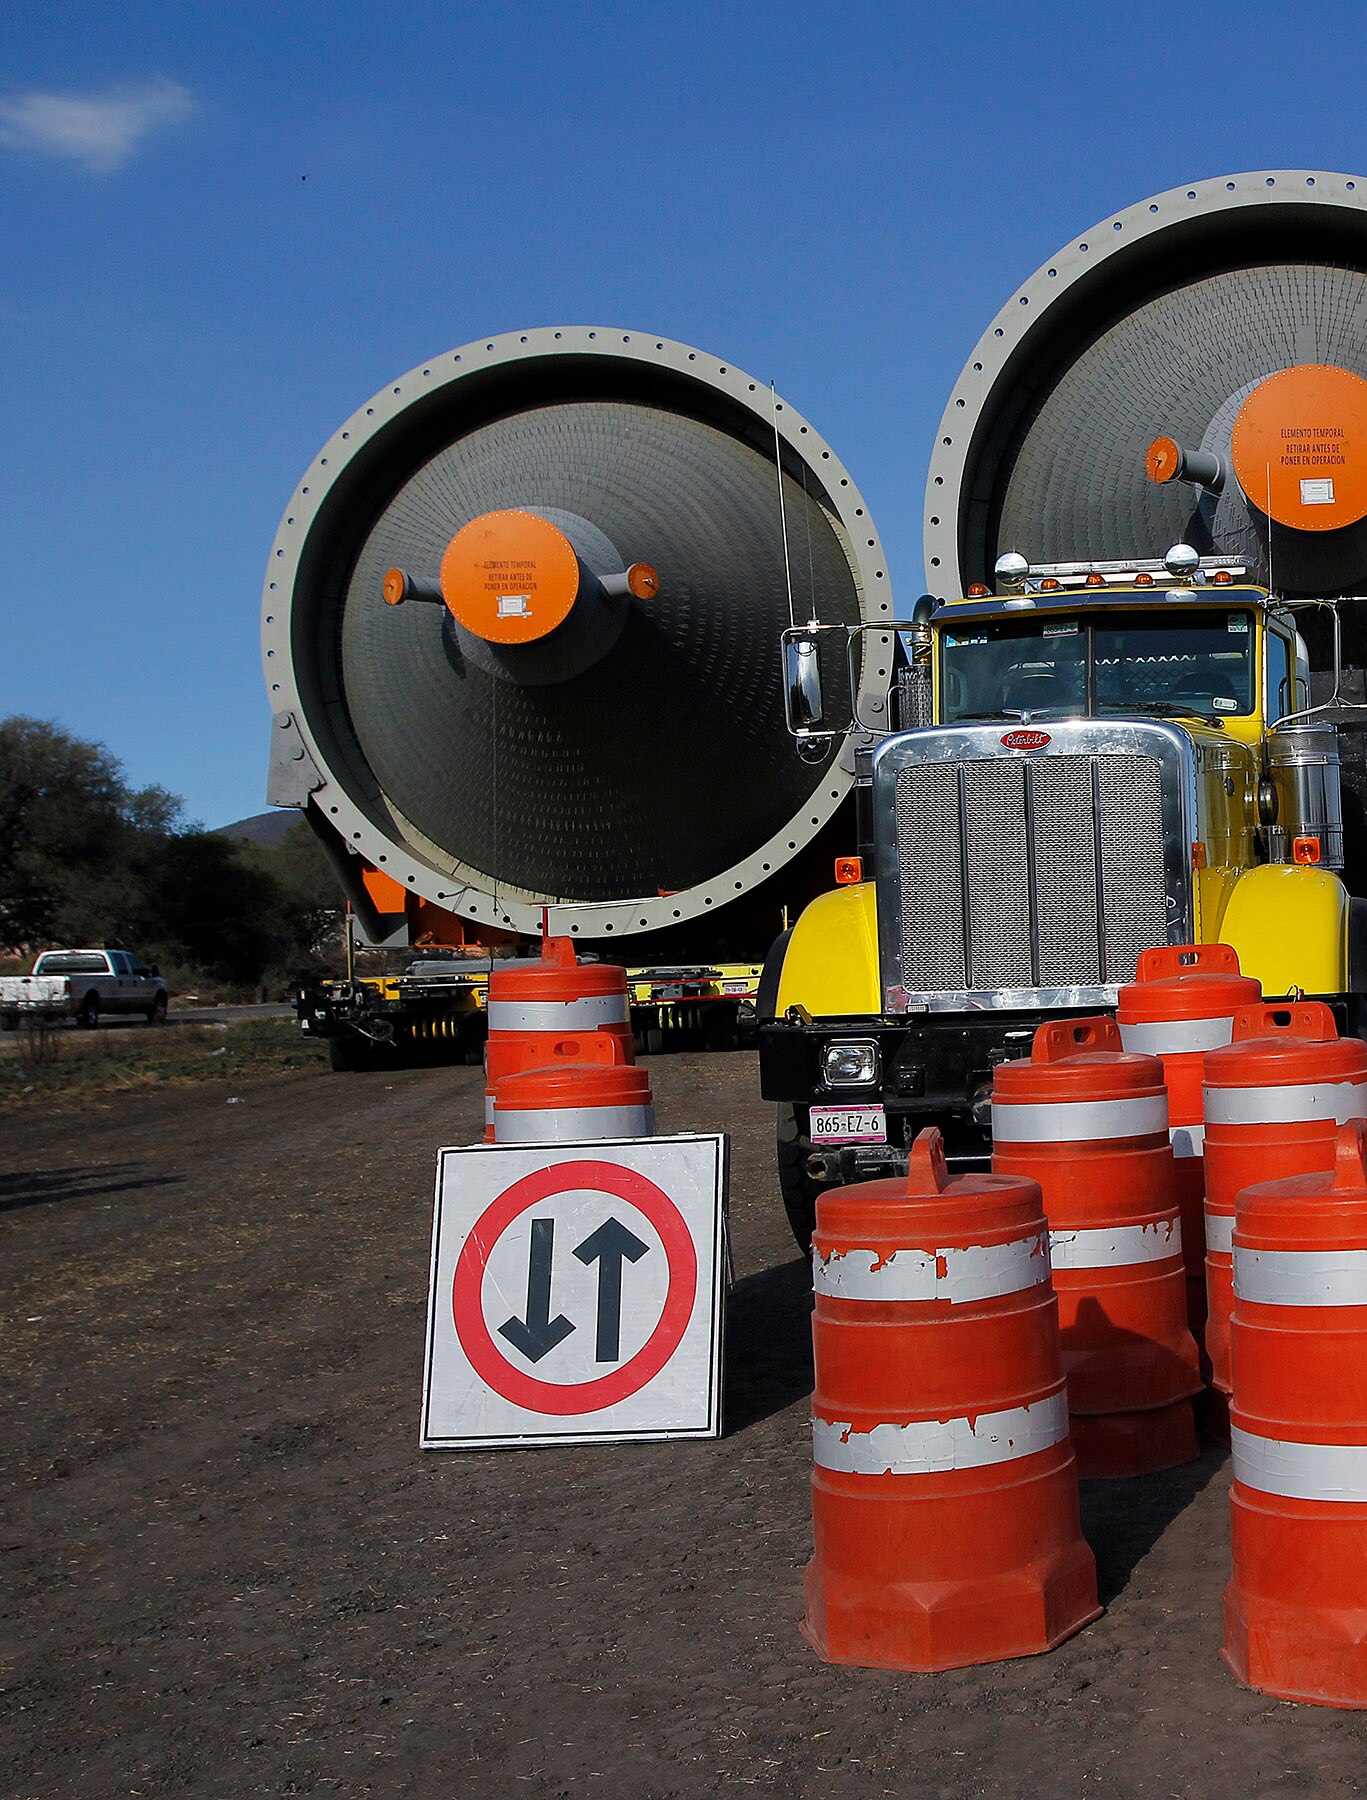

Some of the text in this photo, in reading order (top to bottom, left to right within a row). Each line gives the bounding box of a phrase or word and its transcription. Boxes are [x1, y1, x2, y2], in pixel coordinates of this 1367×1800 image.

[1281, 428, 1344, 438] ELEMENTO TEMPORAL
[1286, 444, 1340, 453] RETIRAR ANTES DE
[1281, 456, 1300, 465] PONER
[1302, 456, 1310, 465] EN
[484, 582, 500, 590] PONER
[502, 582, 508, 590] EN
[1006, 733, 1048, 746] Peterbilt
[816, 1115, 879, 1133] 865-EZ-6
